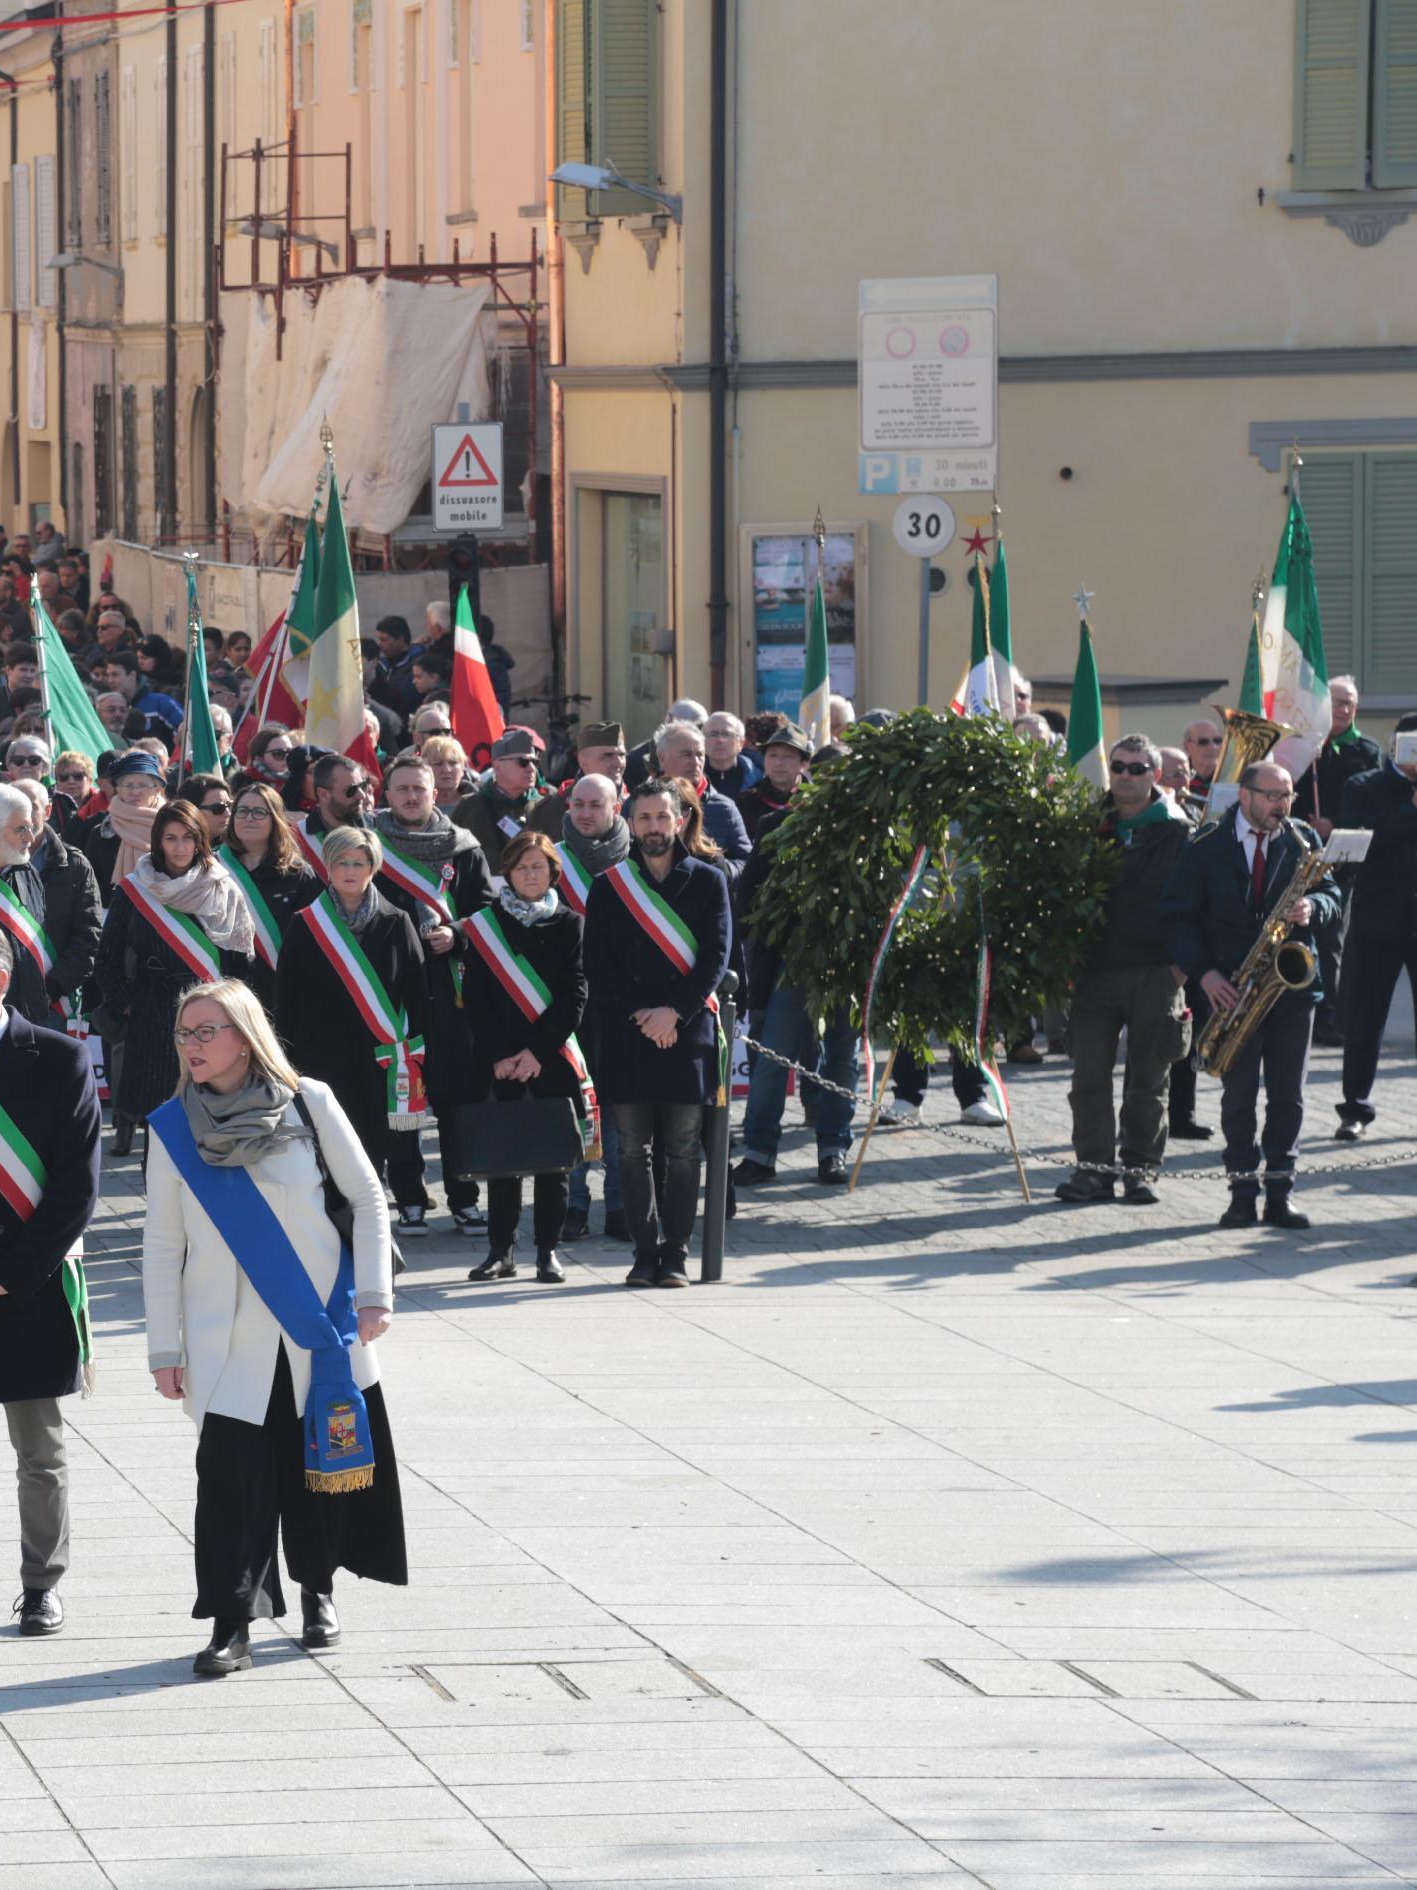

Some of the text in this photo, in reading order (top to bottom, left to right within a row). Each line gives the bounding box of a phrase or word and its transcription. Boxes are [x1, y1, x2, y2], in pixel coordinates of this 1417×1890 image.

[866, 458, 891, 491] P
[439, 494, 497, 505] dissuasore
[450, 510, 488, 522] mobile
[907, 512, 941, 539] 30
